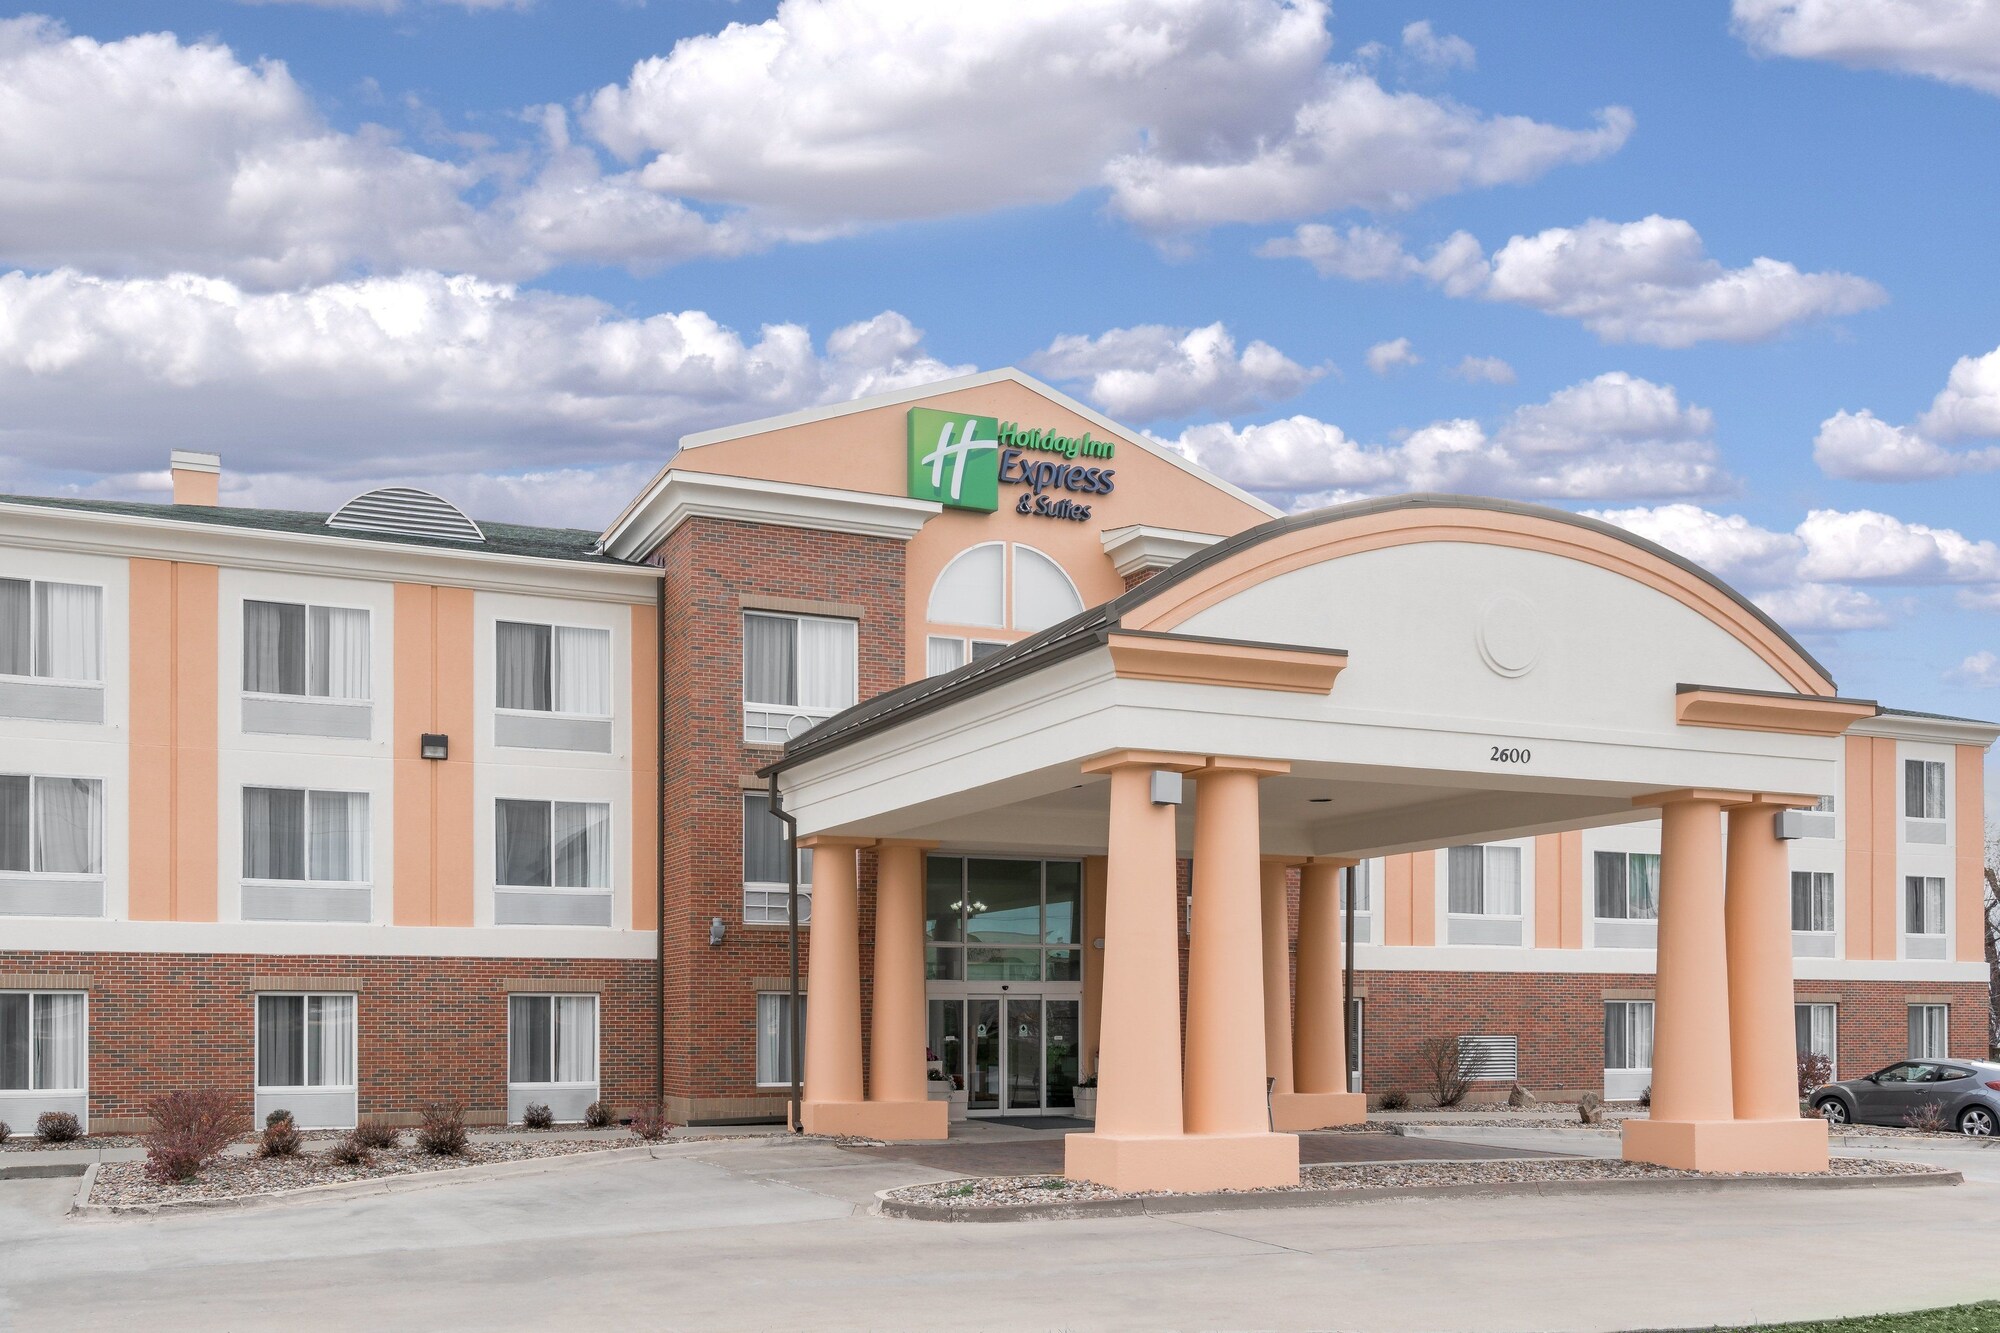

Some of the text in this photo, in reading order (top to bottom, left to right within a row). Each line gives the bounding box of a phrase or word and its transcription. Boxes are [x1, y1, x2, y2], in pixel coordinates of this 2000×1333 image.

[998, 421, 1115, 460] Holiday Inn
[998, 449, 1115, 496] Express
[1016, 493, 1092, 522] & Suites
[1490, 746, 1531, 764] 2600
